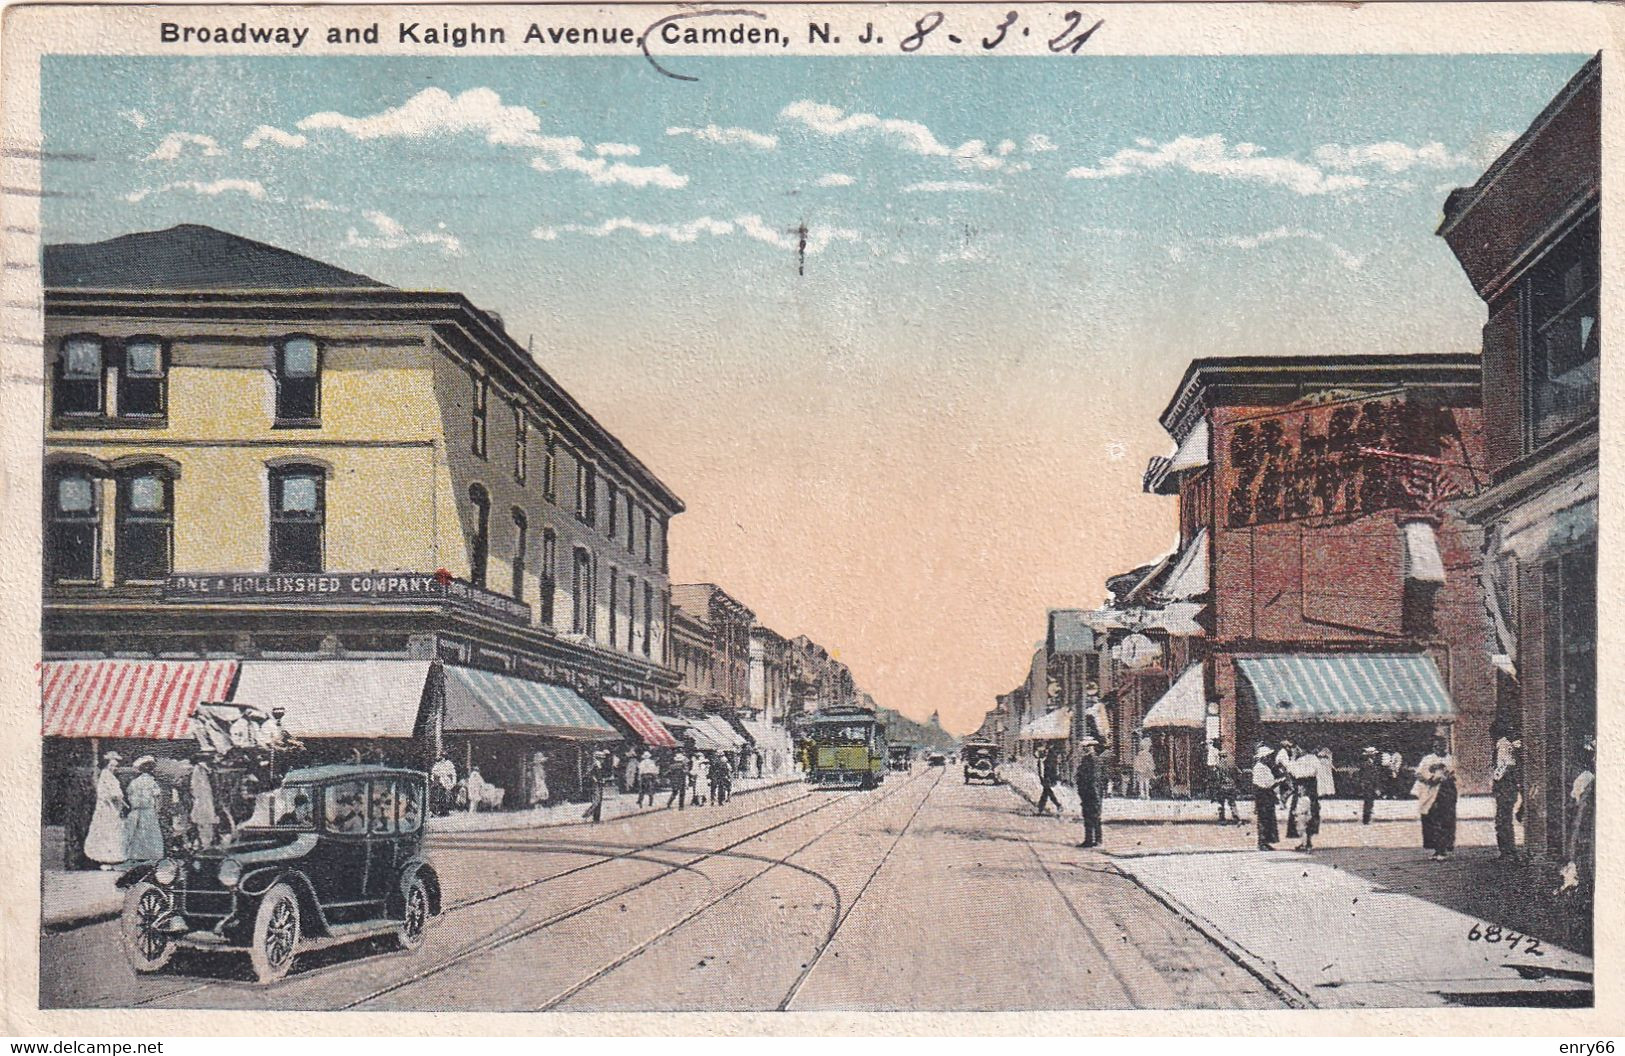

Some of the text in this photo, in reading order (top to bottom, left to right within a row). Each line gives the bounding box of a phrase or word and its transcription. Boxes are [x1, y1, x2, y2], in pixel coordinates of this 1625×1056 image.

[160, 22, 883, 48] Broadway and Kaighn Avenue, Camden, N. J.
[1467, 922, 1544, 956] 6842
